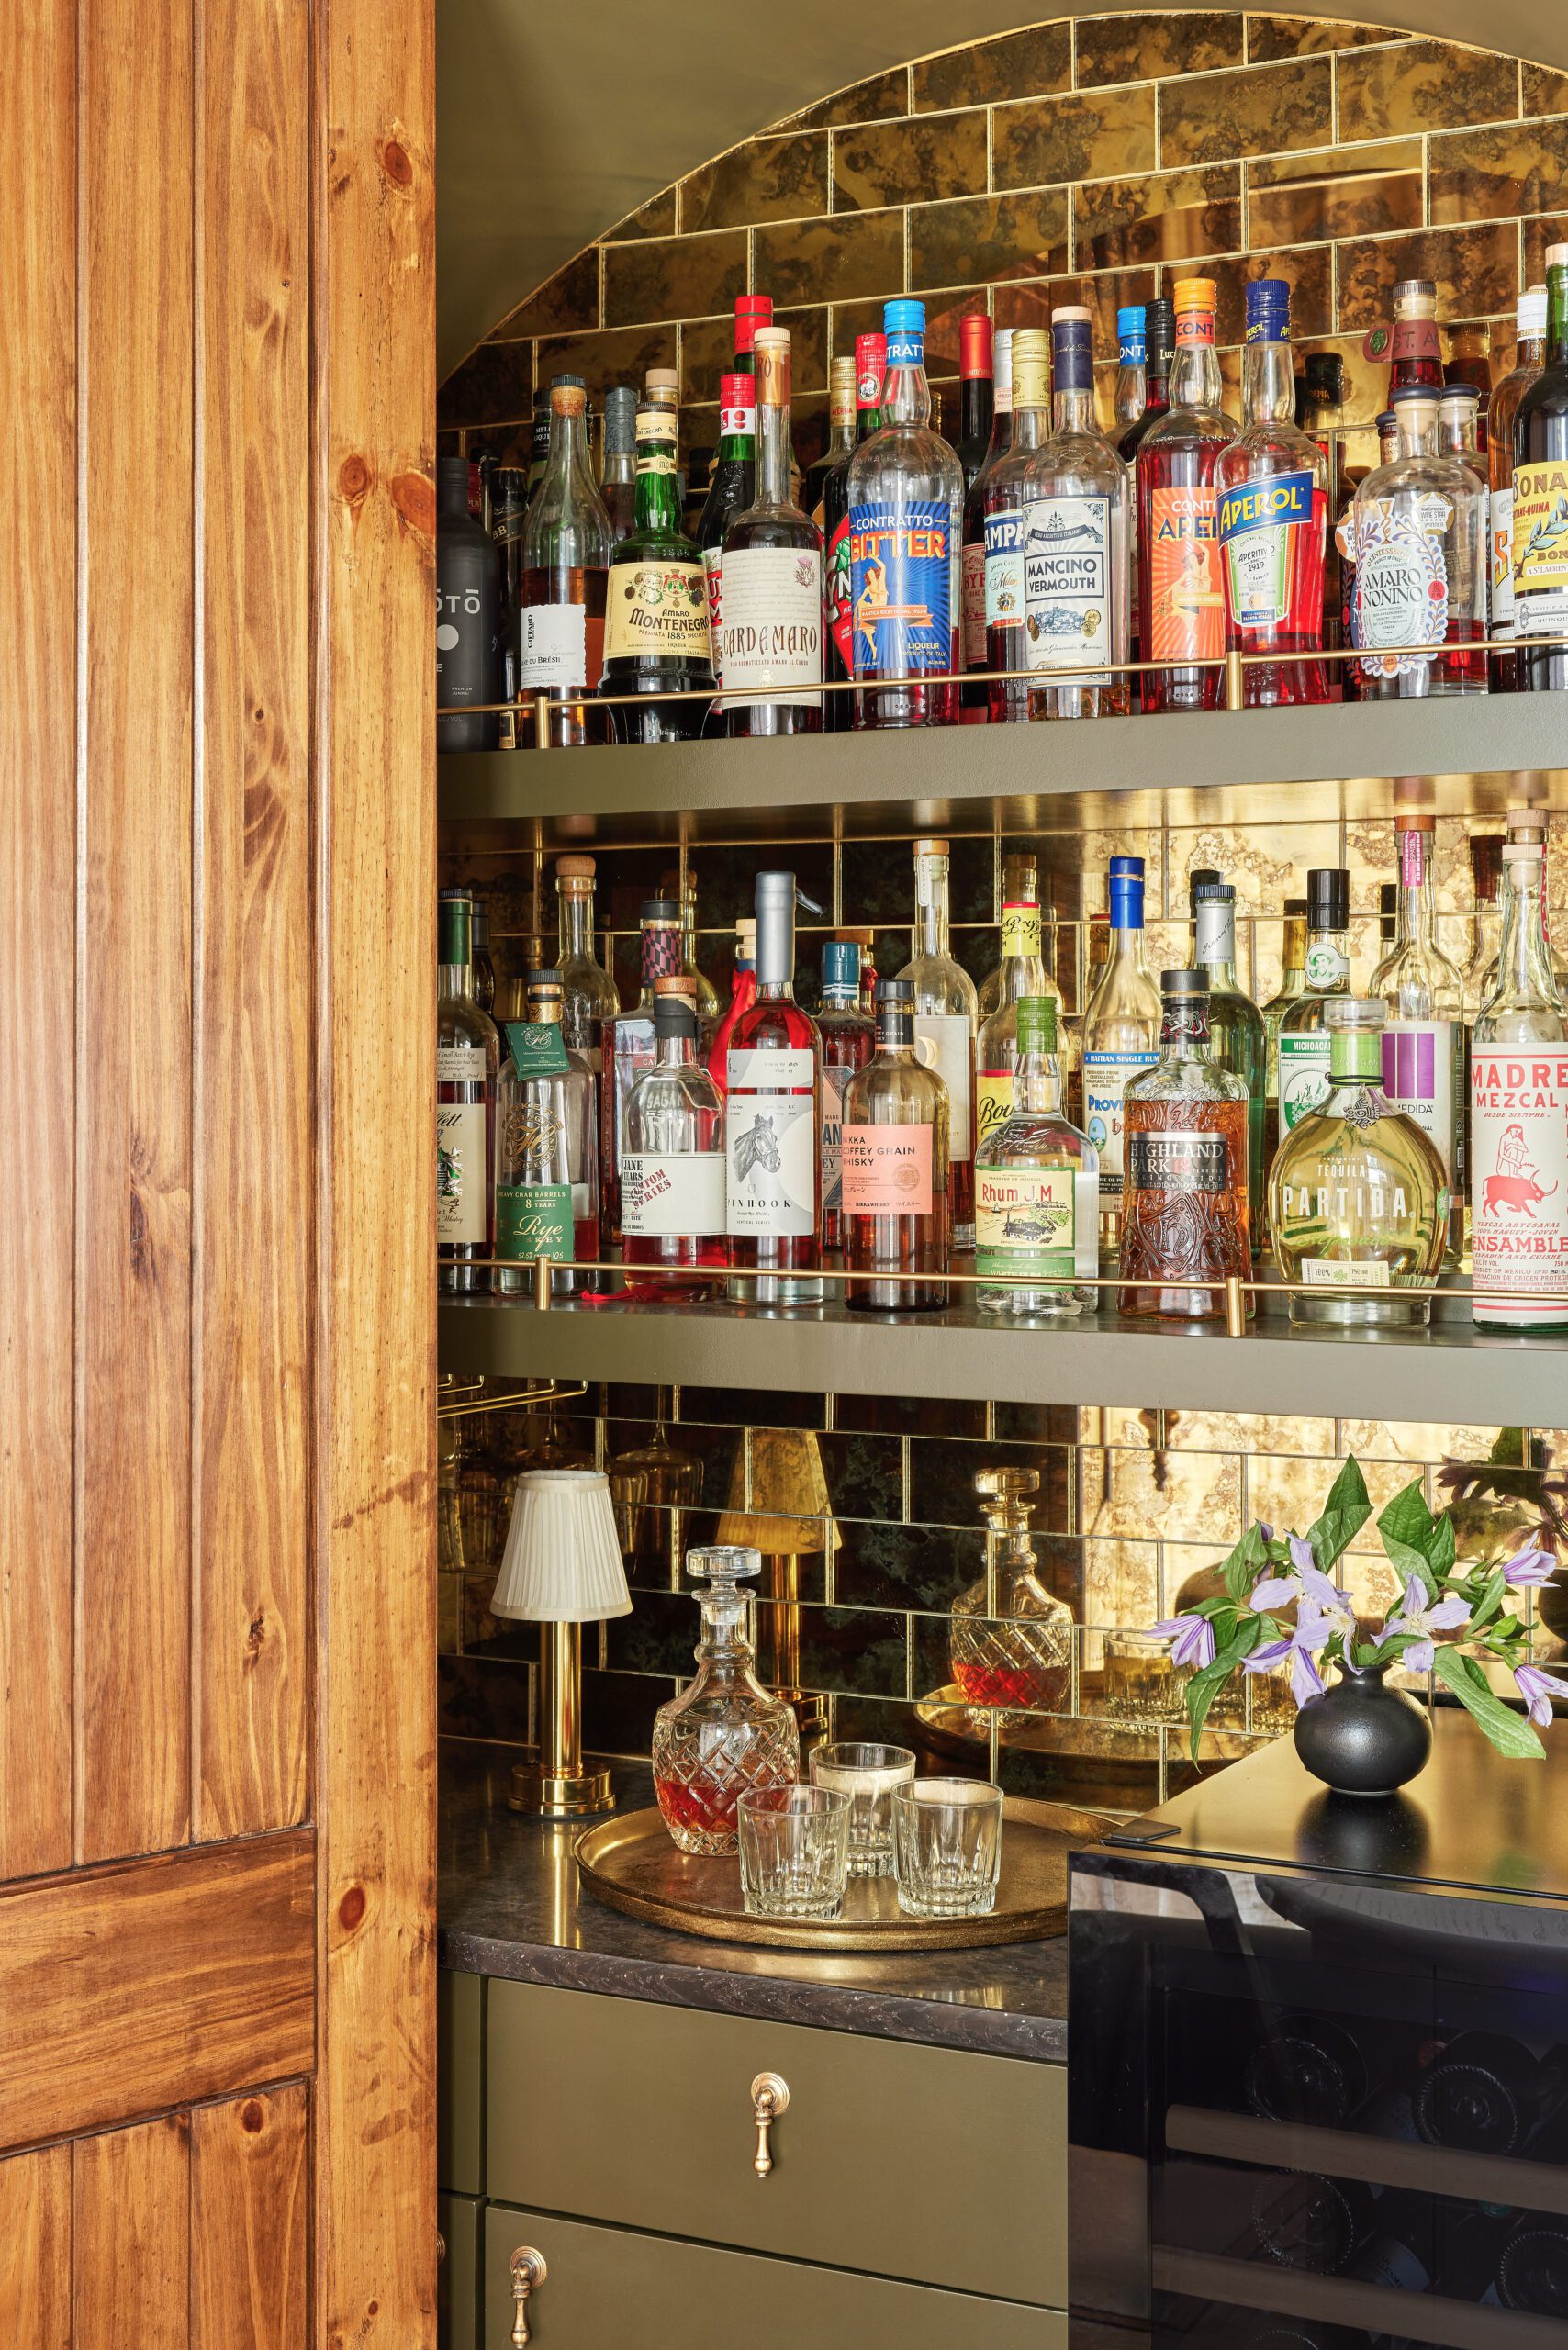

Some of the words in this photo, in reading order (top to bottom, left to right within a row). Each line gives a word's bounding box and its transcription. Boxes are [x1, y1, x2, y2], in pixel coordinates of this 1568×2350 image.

[1220, 487, 1302, 536] APEROL
[857, 514, 933, 531] CONTRATTO
[851, 529, 946, 563] BITTER
[1028, 558, 1097, 577] MANCINO
[1249, 561, 1265, 573] 1919
[1029, 577, 1095, 593] VERMOUTH
[1364, 568, 1421, 591] AMARO
[1364, 586, 1423, 607] NONINO
[629, 607, 710, 632] MONTENEGRO
[662, 608, 689, 617] AMARO
[667, 632, 686, 640] 1885
[723, 625, 817, 658] CARDAMARO
[908, 642, 940, 651] LIQUEUR
[1090, 1055, 1115, 1063] HAITIAN
[1116, 1055, 1144, 1063] SINGLE
[1473, 1063, 1568, 1089] MADRE
[1476, 1092, 1559, 1108] MEZCAL
[843, 1136, 866, 1145] NIKKA
[843, 1147, 873, 1156] COFFEY
[877, 1147, 915, 1156] GRAIN
[1131, 1143, 1224, 1158] HIGHLAND
[1131, 1158, 1171, 1175] PARK
[1174, 1159, 1189, 1173] 18
[1317, 1164, 1365, 1178] TEQUILA
[982, 1183, 1018, 1203] Rhum
[1024, 1185, 1053, 1202] J.M
[525, 1199, 532, 1209] 8
[1283, 1187, 1407, 1218] PARTIDA
[513, 1214, 564, 1252] Rye
[1473, 1236, 1568, 1253] ENSAMBLE
[1315, 1268, 1330, 1277] 100%
